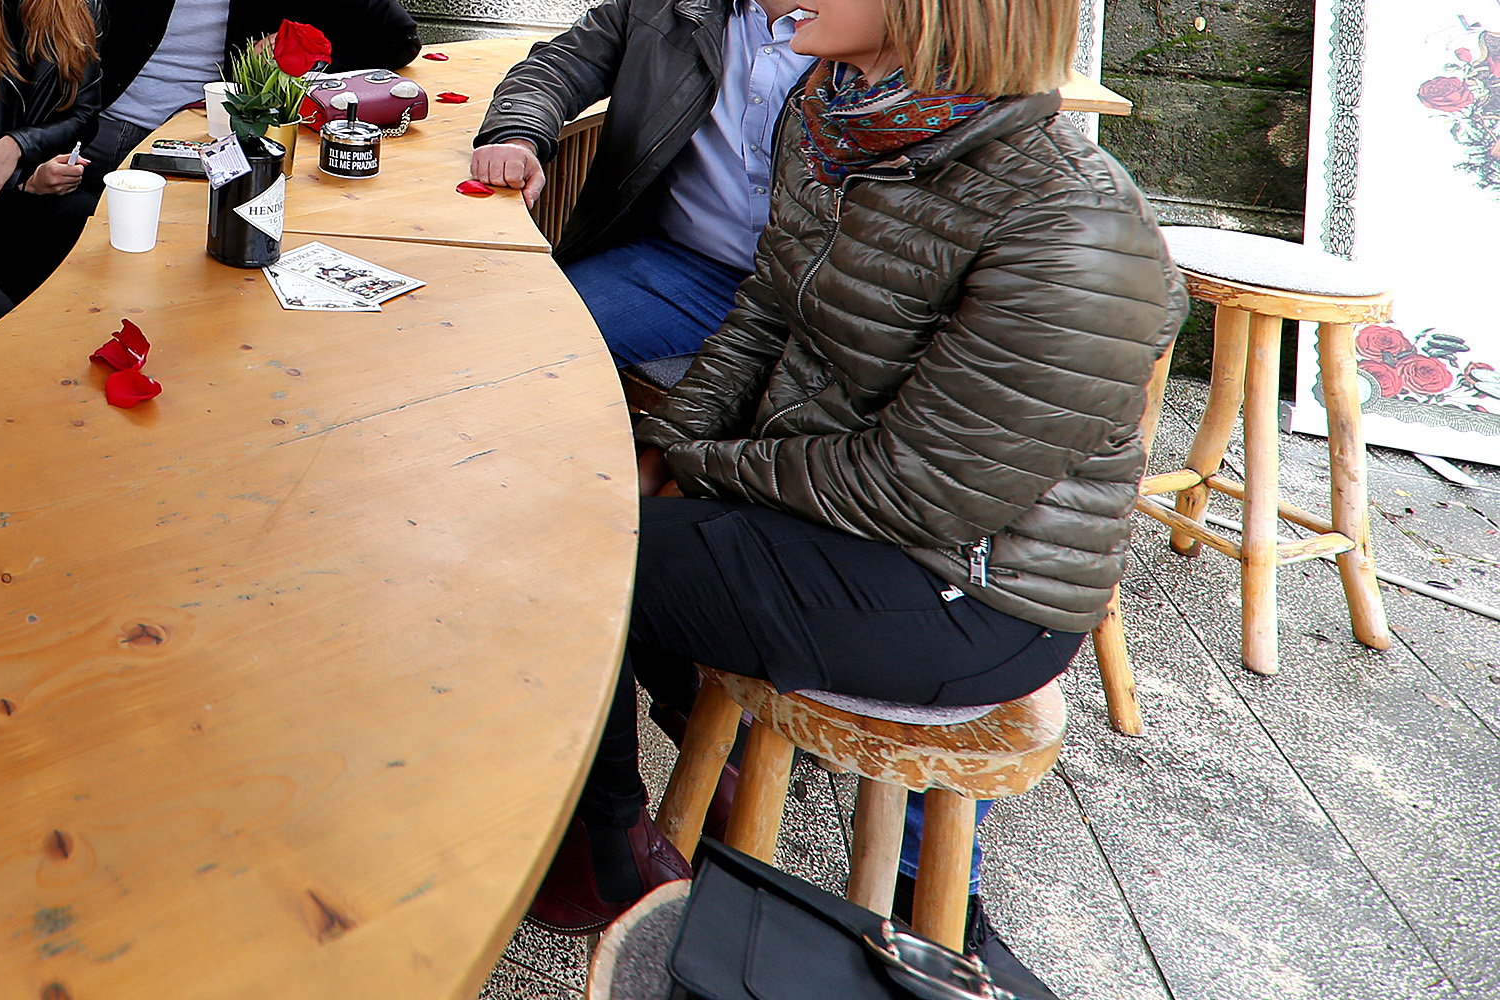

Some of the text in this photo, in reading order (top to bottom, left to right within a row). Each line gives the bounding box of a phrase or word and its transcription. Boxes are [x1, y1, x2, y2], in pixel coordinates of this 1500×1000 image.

[329, 147, 339, 159] ILI
[339, 150, 352, 161] ME
[329, 157, 339, 169] ILI
[339, 160, 351, 170] ME
